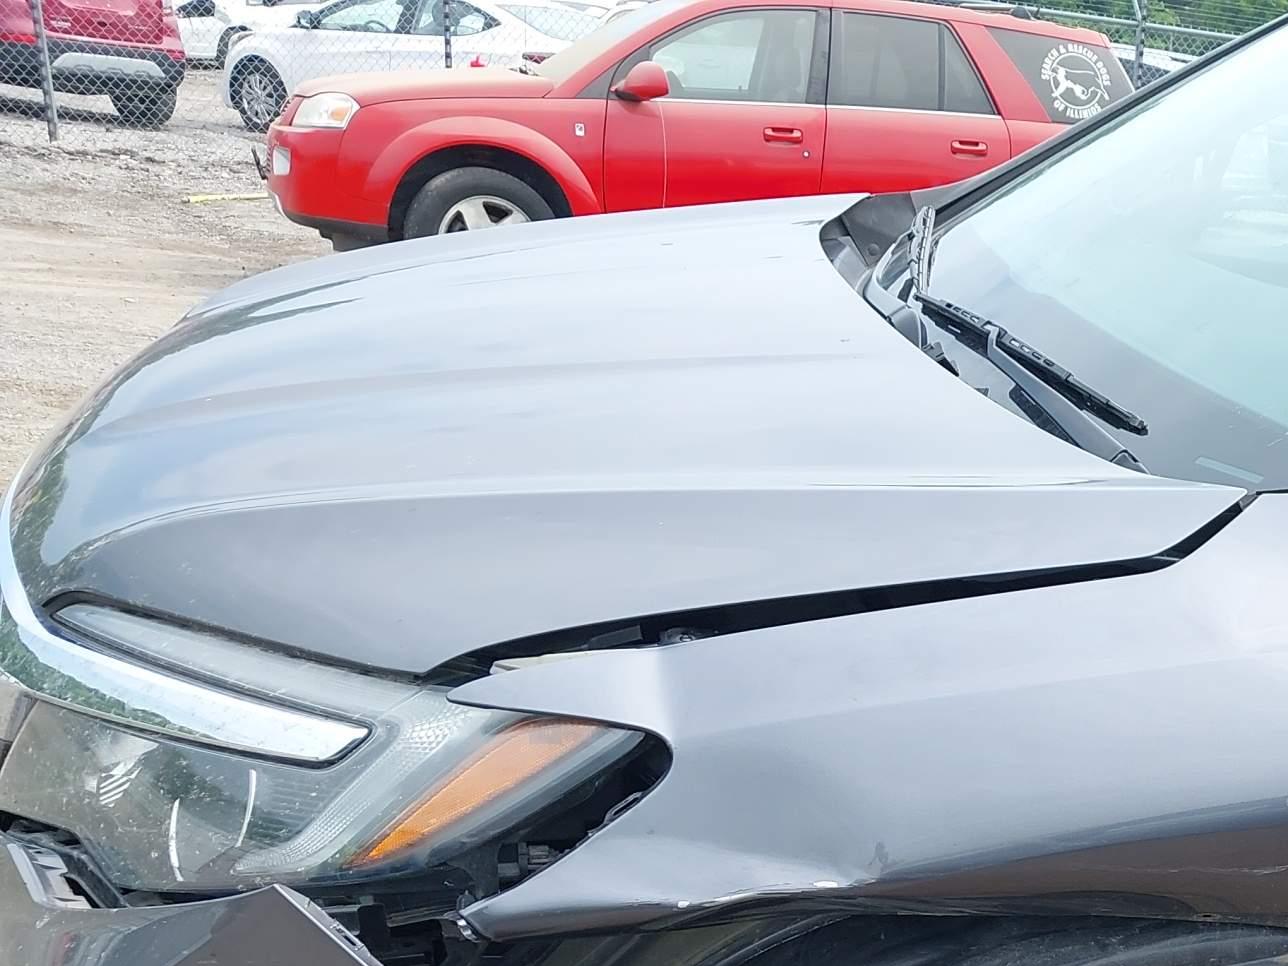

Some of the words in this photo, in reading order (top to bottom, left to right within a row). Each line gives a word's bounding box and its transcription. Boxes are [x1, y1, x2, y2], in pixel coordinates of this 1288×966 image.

[1041, 48, 1060, 80] SEARCH
[1059, 44, 1067, 54] &
[1068, 44, 1098, 62] RESCUE
[1096, 62, 1111, 86] DOGS
[1053, 99, 1066, 112] OF
